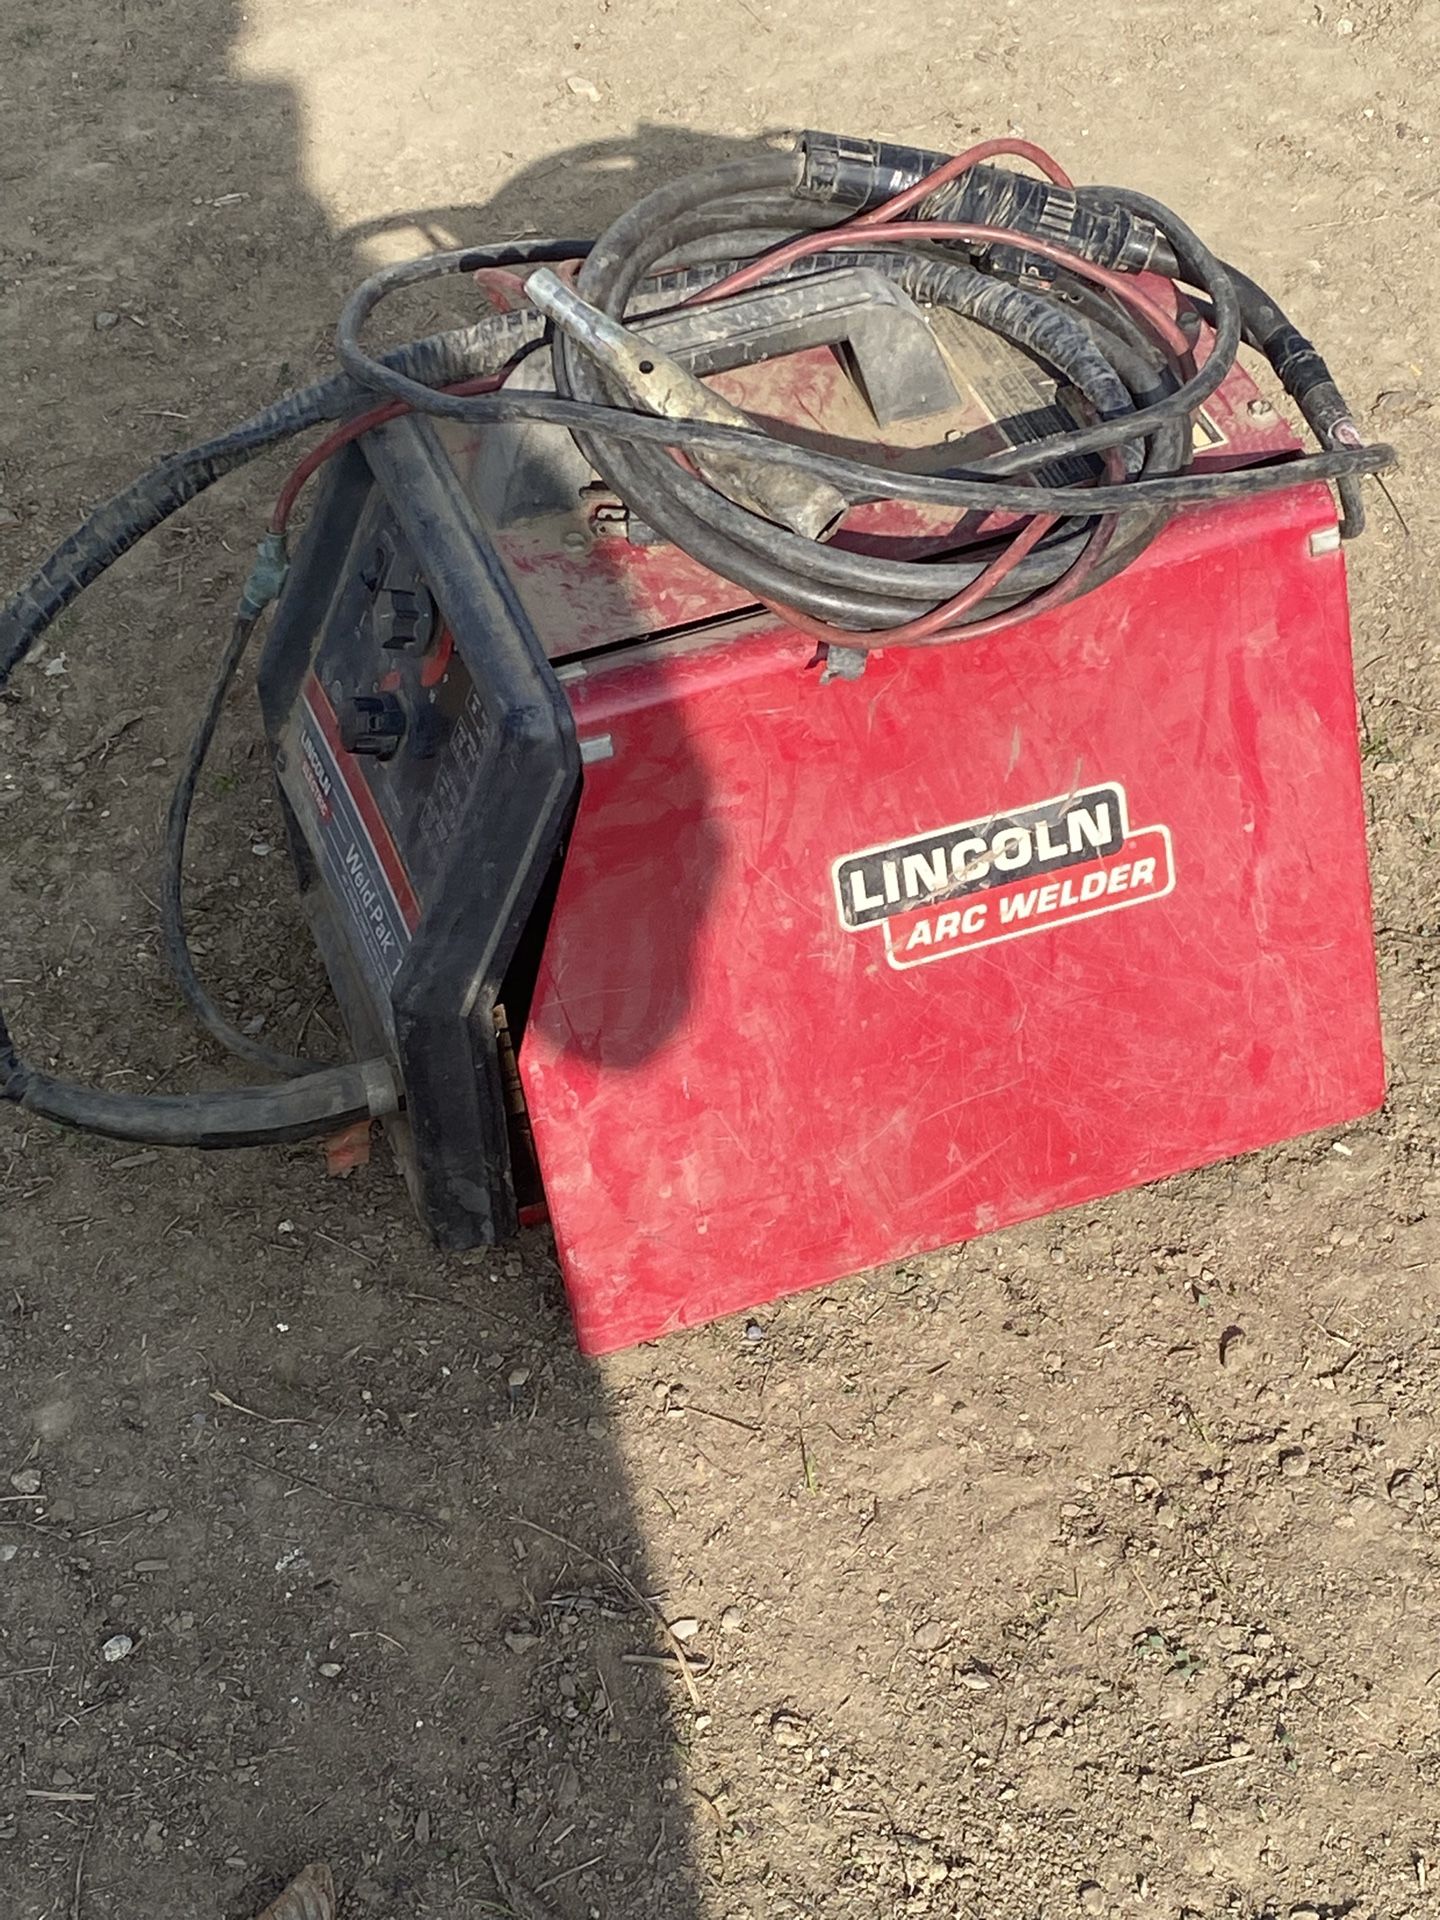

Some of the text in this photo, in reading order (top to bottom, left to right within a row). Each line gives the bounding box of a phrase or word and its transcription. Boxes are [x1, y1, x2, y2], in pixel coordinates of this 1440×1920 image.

[300, 730, 332, 797] LINCOLN
[345, 843, 396, 955] Weld-Pak
[849, 802, 1114, 912] LINCOLN
[905, 856, 1157, 951] ARC WELDER
